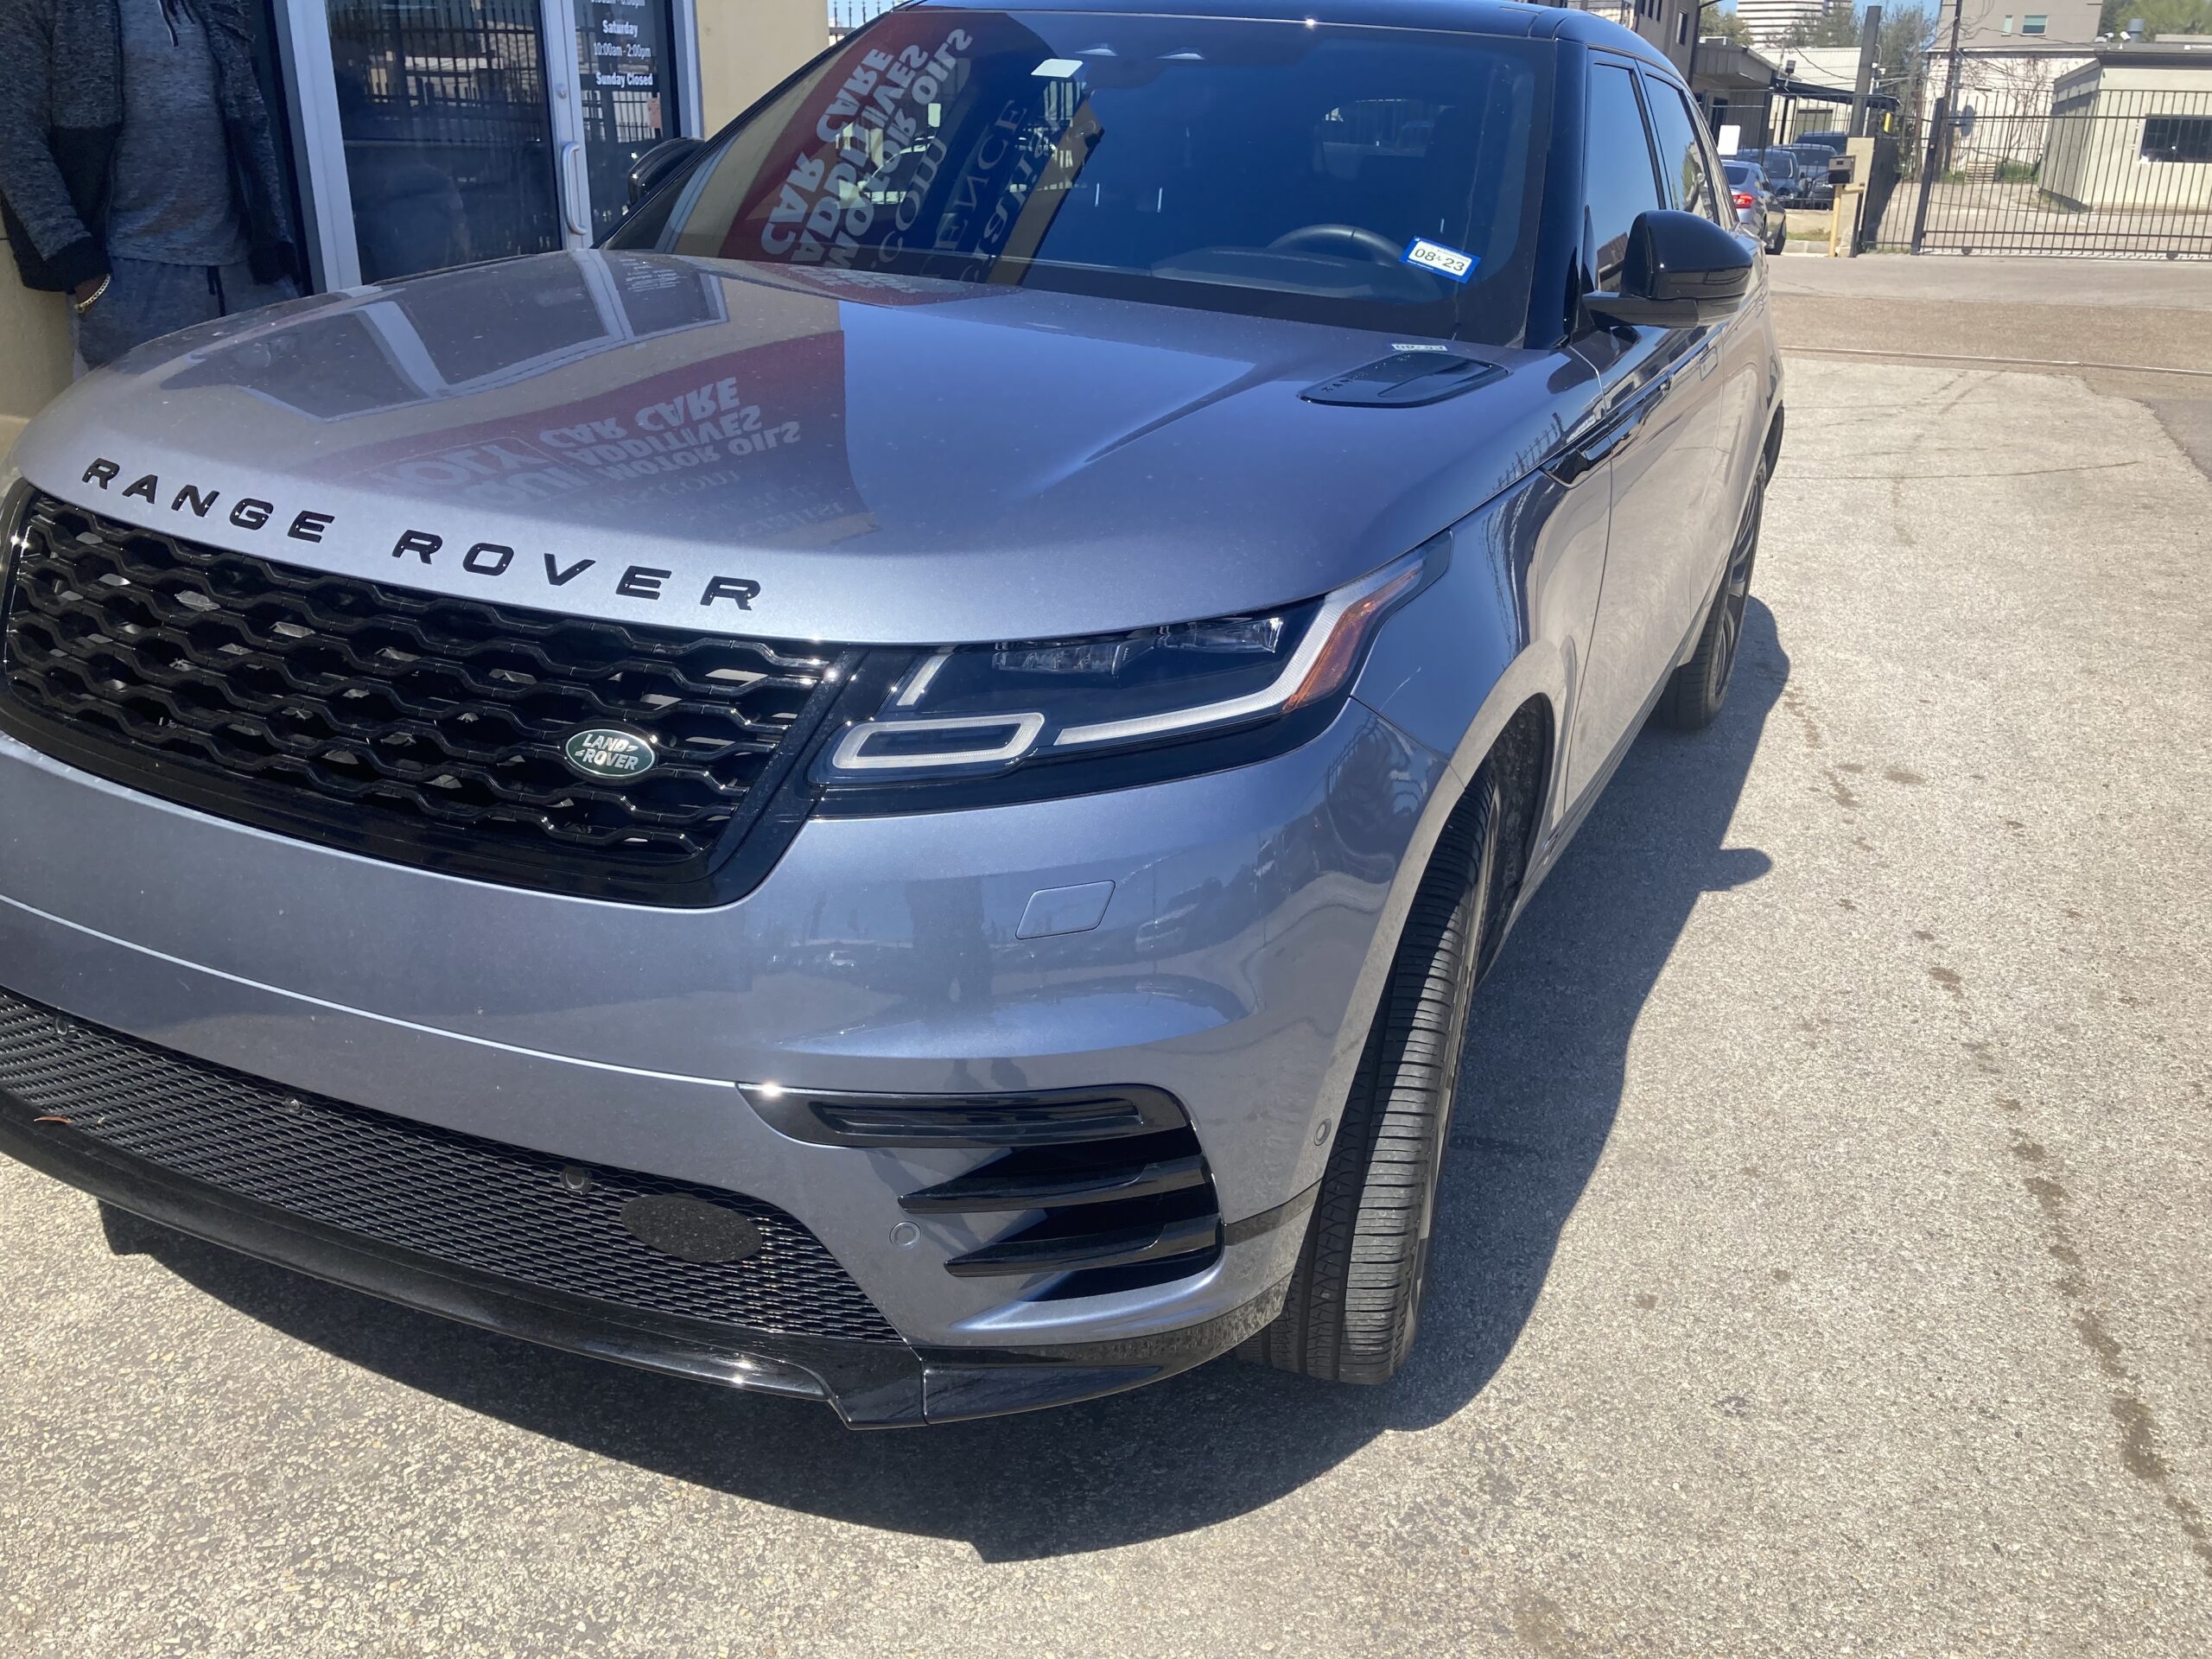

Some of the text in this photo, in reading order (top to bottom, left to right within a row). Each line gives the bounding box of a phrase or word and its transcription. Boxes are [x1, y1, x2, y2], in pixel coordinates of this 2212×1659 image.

[602, 20, 639, 37] Saturday
[594, 42, 623, 56] 10:00am
[626, 44, 652, 60] 2:00pm
[596, 72, 653, 88] Sunday Closed
[82, 457, 762, 610] RANGE ROVER
[582, 734, 630, 753] LAND
[582, 748, 639, 771] ROVER
